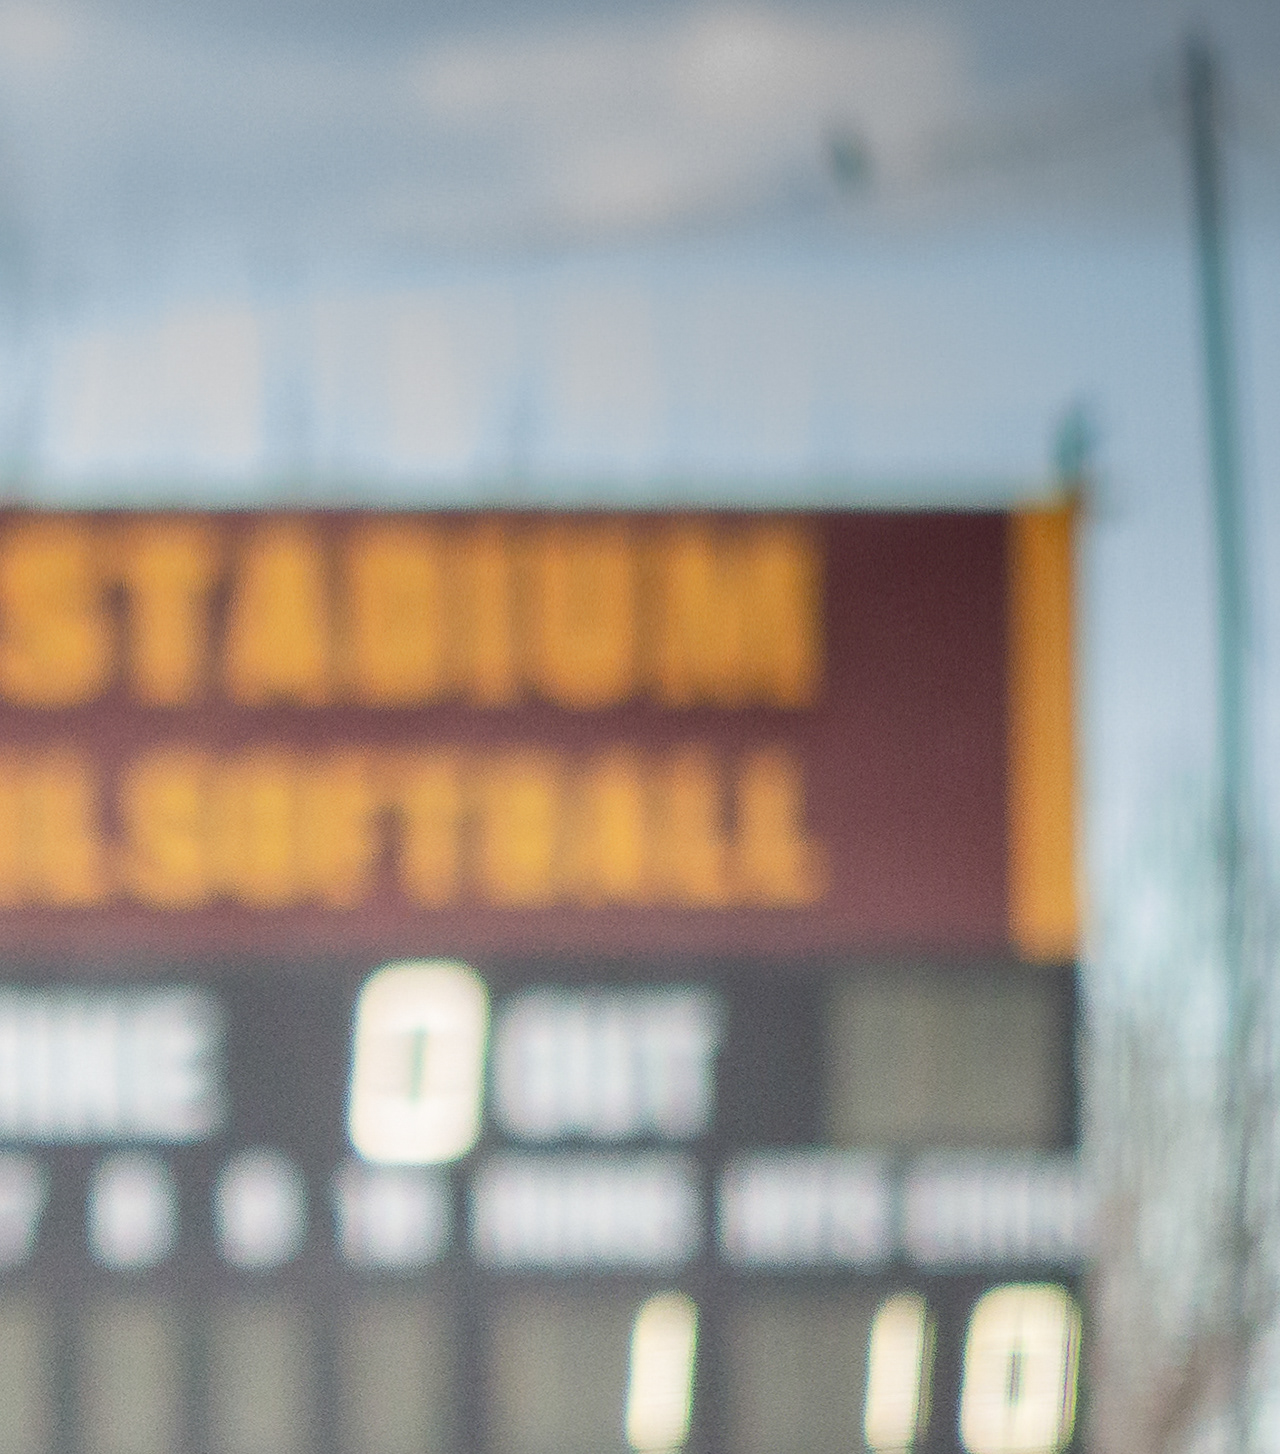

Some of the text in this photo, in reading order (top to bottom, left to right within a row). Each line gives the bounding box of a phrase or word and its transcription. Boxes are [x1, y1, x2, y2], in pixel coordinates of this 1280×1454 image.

[116, 746, 826, 908] SOFTBALL
[352, 958, 490, 1167] 0
[494, 986, 724, 1142] OUT
